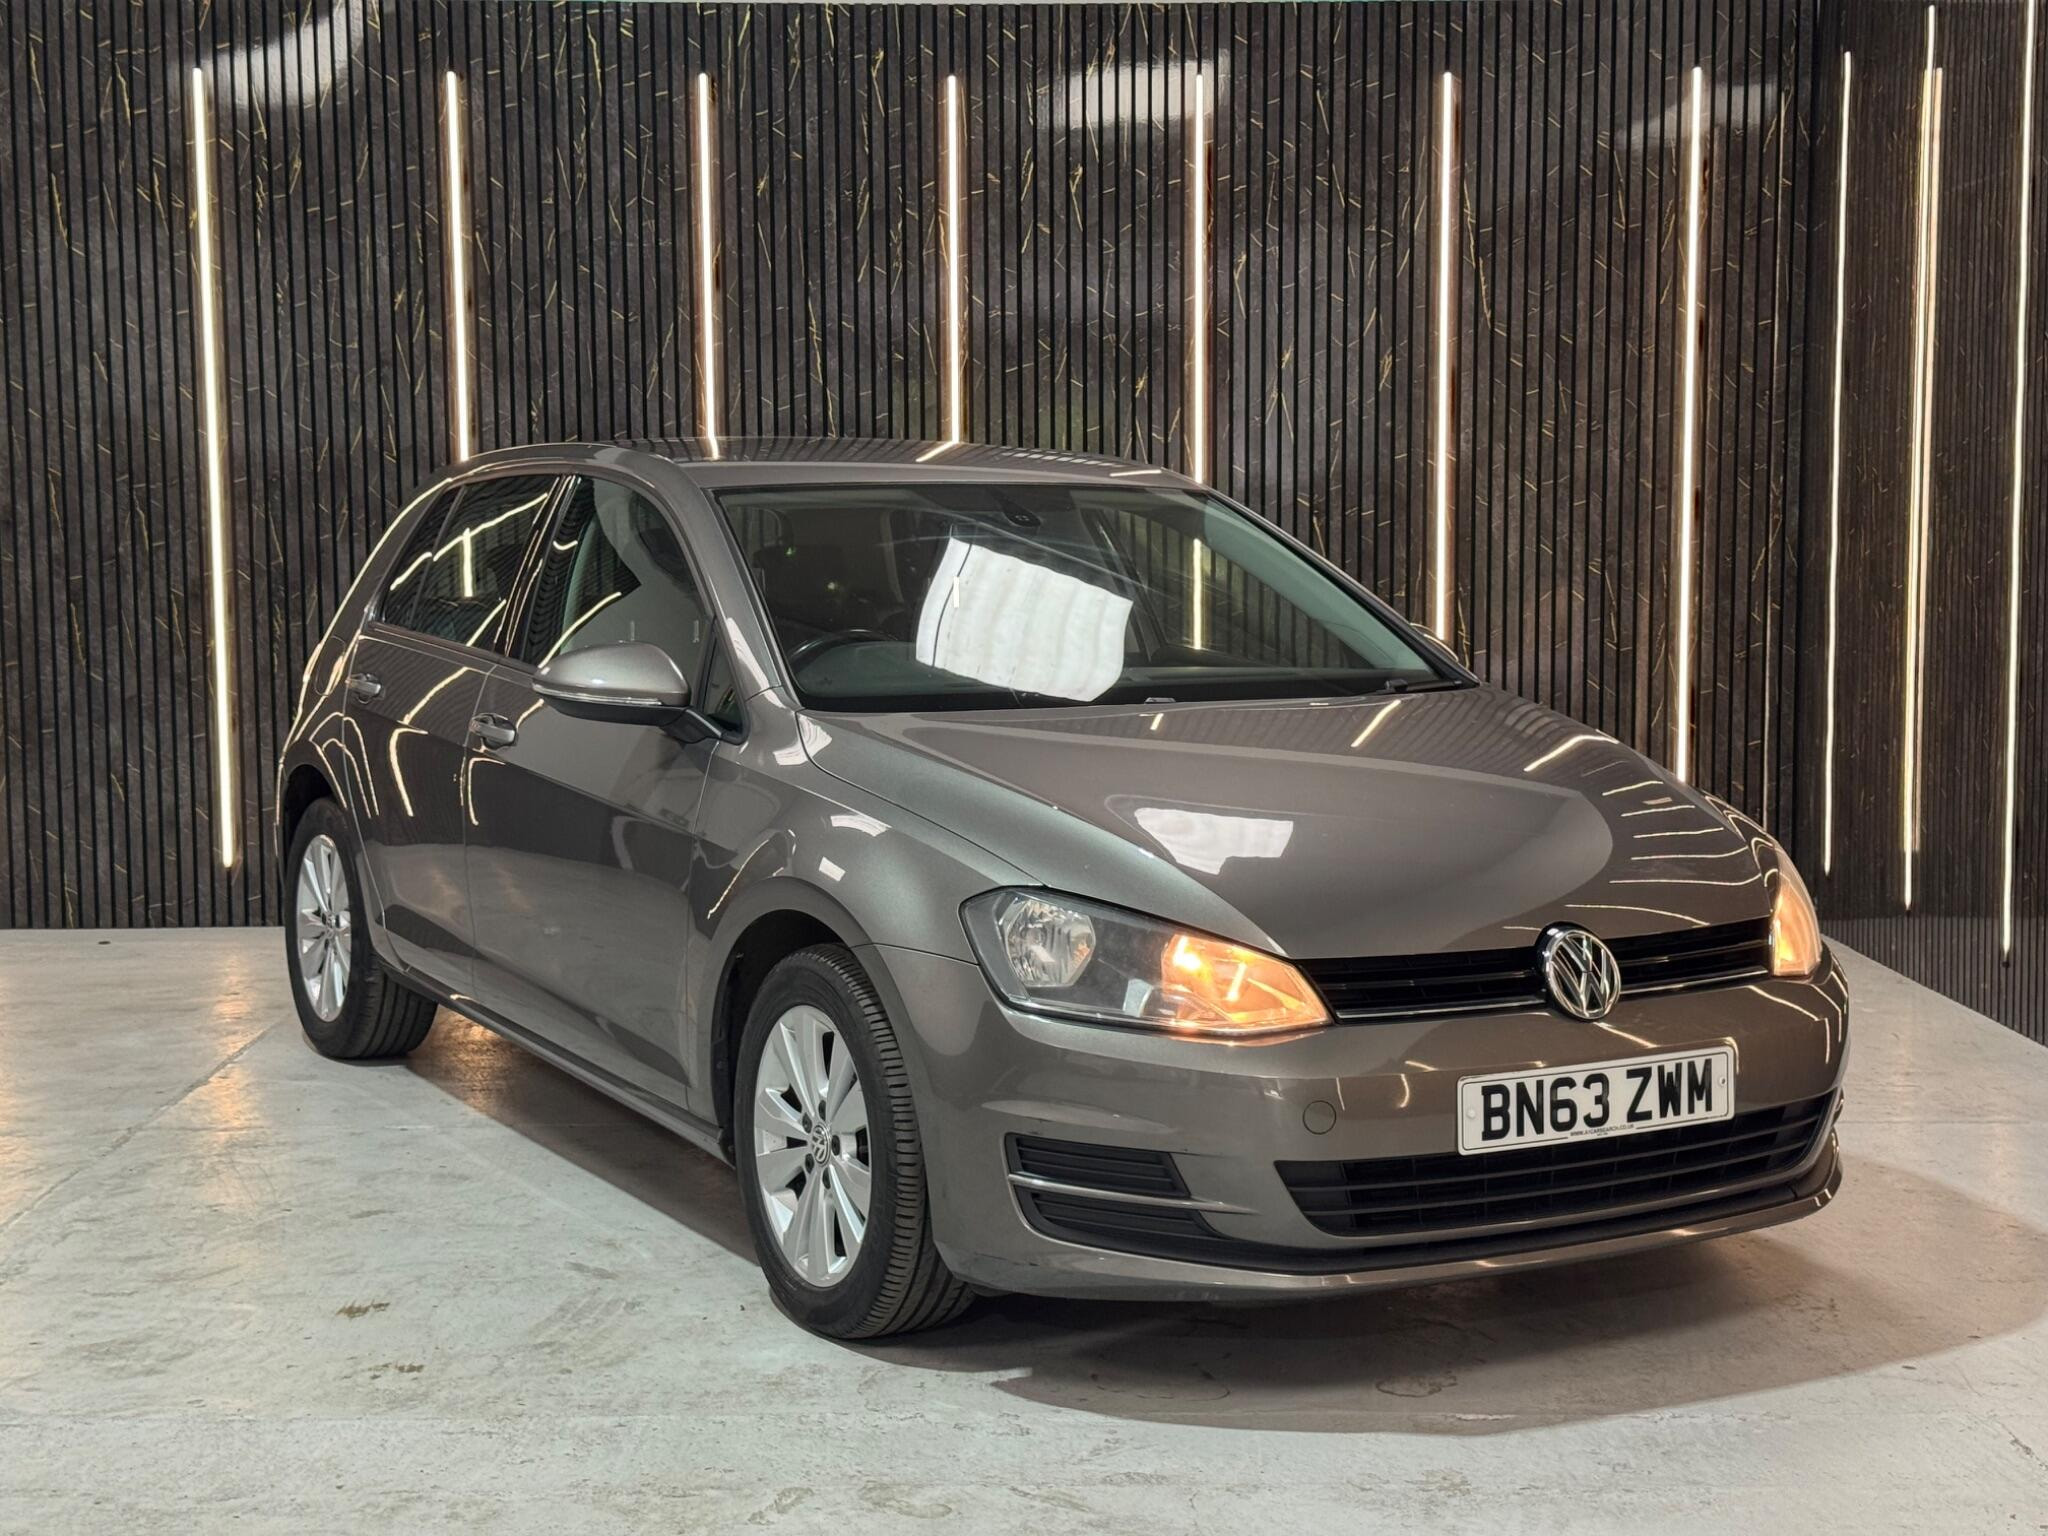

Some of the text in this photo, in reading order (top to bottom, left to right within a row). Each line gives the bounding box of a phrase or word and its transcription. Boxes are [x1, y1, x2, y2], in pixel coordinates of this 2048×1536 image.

[1547, 931, 1620, 1018] VW
[1481, 1058, 1712, 1141] BN63 ZWM
